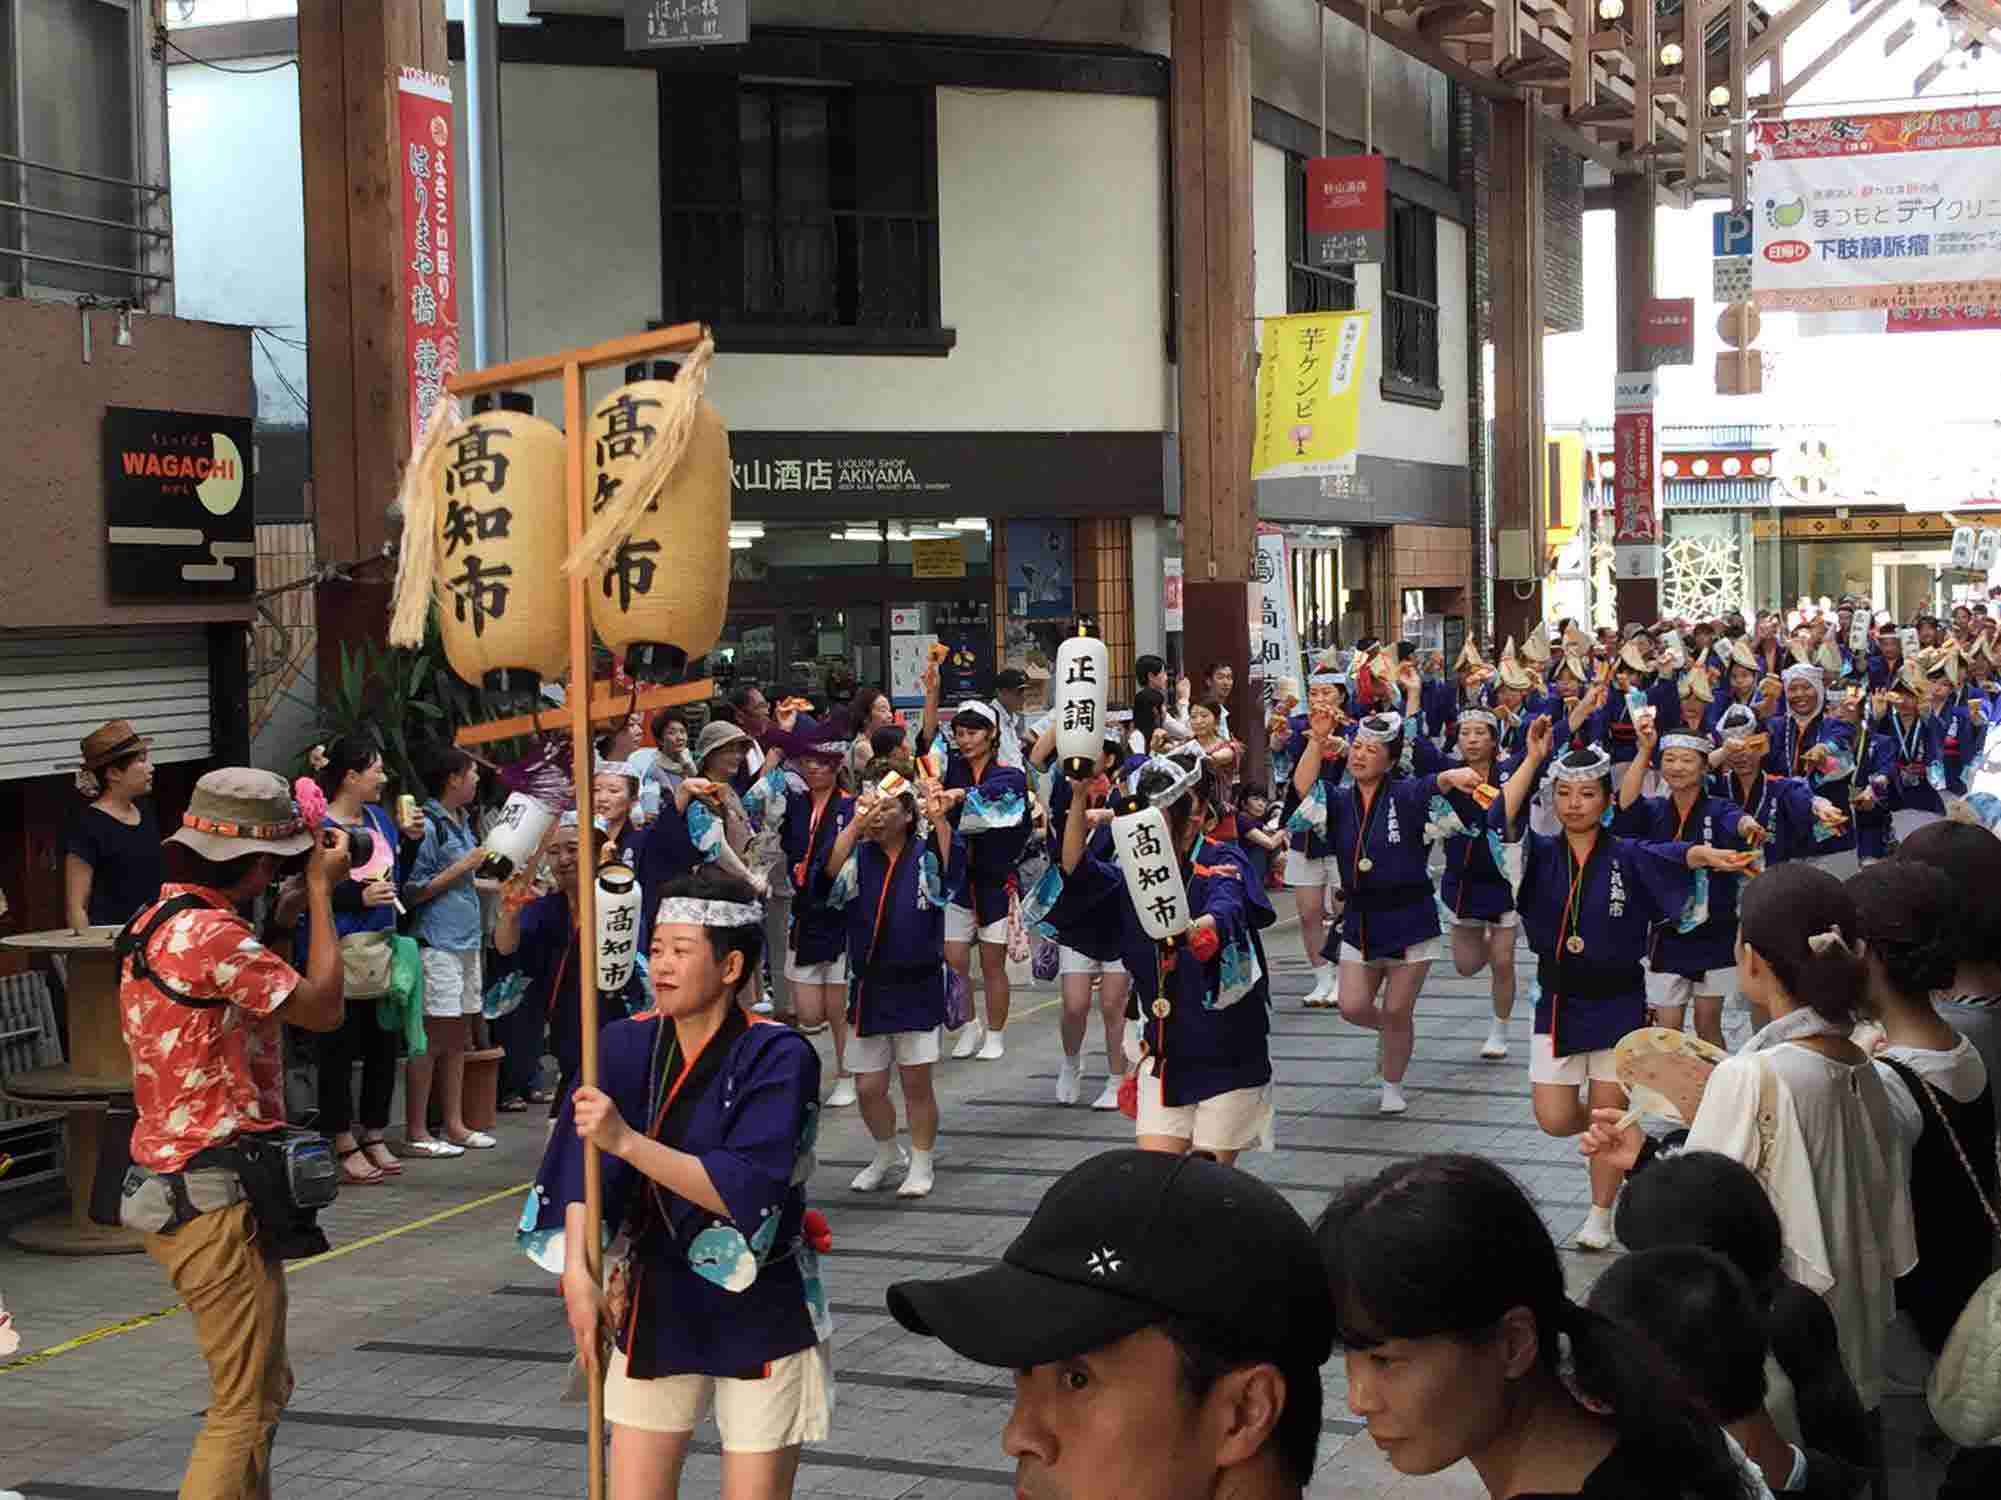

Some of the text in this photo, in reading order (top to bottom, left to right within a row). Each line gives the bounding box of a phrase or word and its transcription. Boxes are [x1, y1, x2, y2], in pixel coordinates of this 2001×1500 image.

[1723, 215, 1751, 253] P
[1814, 234, 1929, 259] 下肢静脈瘤
[122, 452, 234, 481] WAGACHI
[838, 458, 905, 468] LIQUOR SHOP
[838, 468, 916, 482] AKIYAMA
[443, 424, 513, 637] 高知市
[1063, 655, 1097, 733] 正調
[1126, 822, 1178, 929] 高知市
[600, 904, 636, 985] 高知市
